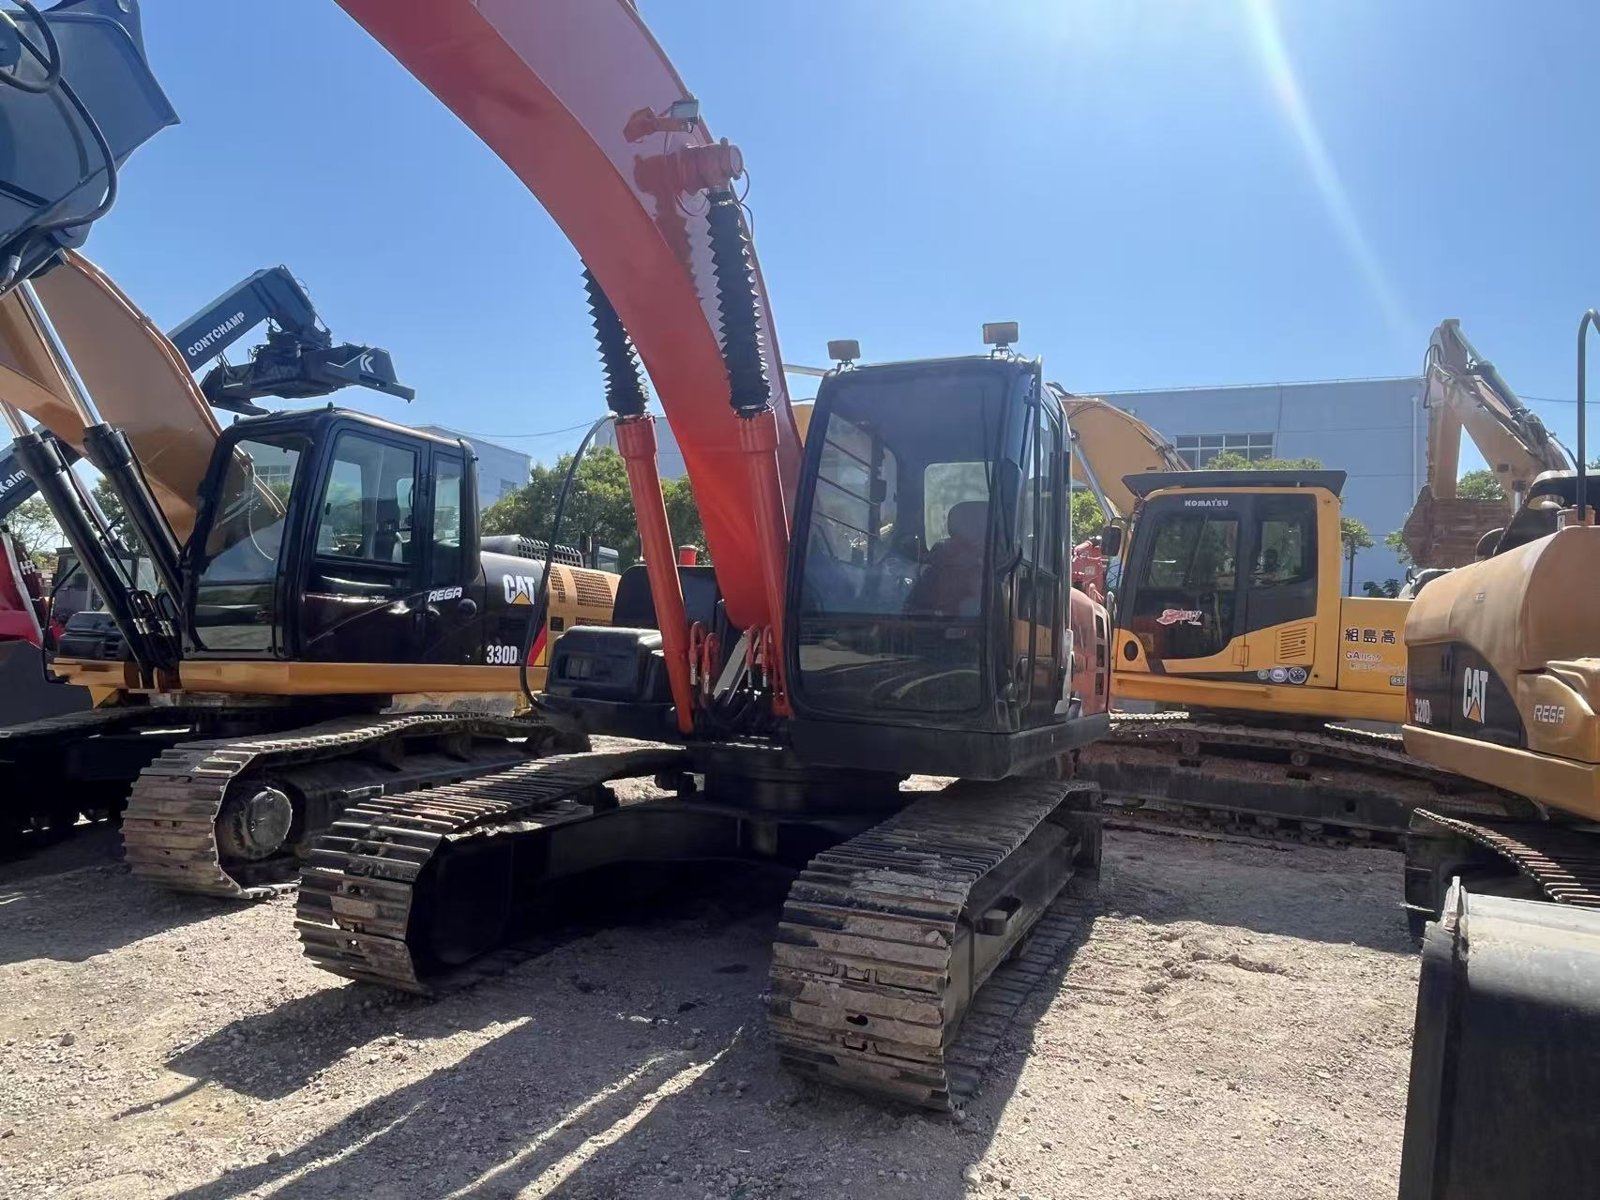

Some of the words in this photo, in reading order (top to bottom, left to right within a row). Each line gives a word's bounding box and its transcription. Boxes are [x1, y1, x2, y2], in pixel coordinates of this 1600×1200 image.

[187, 311, 245, 357] CONTCHAMP
[1184, 499, 1229, 507] KOMATSU
[428, 587, 463, 602] REGA
[502, 574, 535, 606] CAT
[486, 644, 518, 664] 330D
[1462, 667, 1489, 725] CAT
[1533, 704, 1565, 724] REGA
